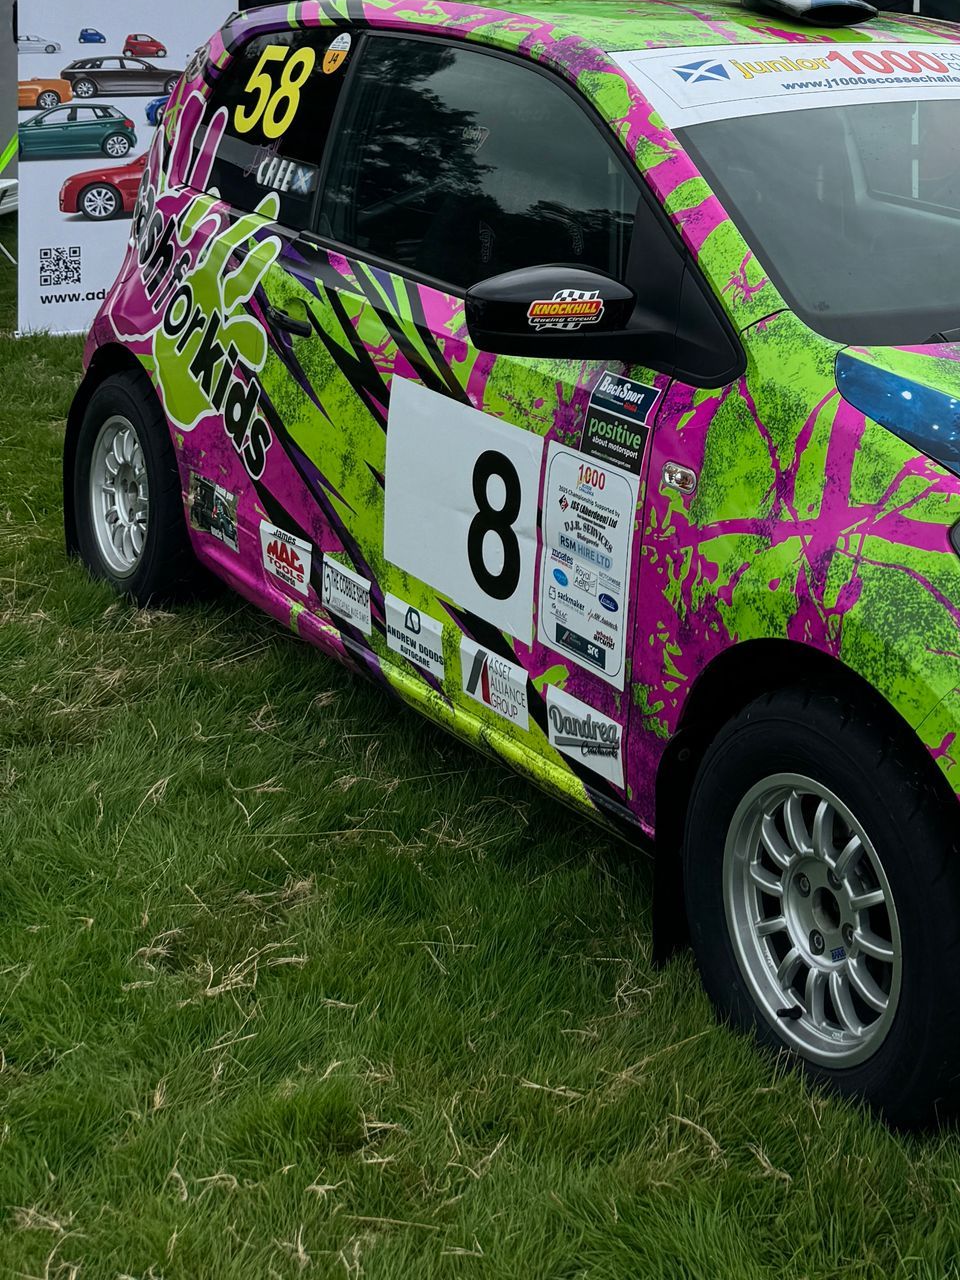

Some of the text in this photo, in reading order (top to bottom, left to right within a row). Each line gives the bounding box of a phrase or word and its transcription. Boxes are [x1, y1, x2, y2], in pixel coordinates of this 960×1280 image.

[728, 56, 831, 80] junior
[826, 50, 950, 74] 1000
[234, 44, 316, 139] 58
[256, 156, 297, 192] CREE
[40, 288, 109, 304] www.ad
[533, 303, 597, 315] KNOCKHILL
[599, 375, 645, 405] BeckSport
[588, 417, 641, 450] positive
[592, 435, 608, 447] about
[608, 442, 638, 460] motorsport
[467, 450, 522, 601] 8
[582, 522, 613, 553] SERVICES
[266, 539, 304, 575] MAC
[560, 535, 577, 552] RSM
[577, 544, 595, 561] HIRE
[597, 551, 611, 569] LTD
[267, 555, 304, 584] TOOLS
[557, 591, 585, 611] sackmaker
[387, 624, 444, 666] ANDREW DODDS
[400, 644, 431, 669] AUTOCARE
[489, 657, 512, 682] ASSET
[490, 678, 527, 709] ALLIANCE
[490, 695, 519, 720] GROUP
[549, 704, 619, 744] Dandrea
